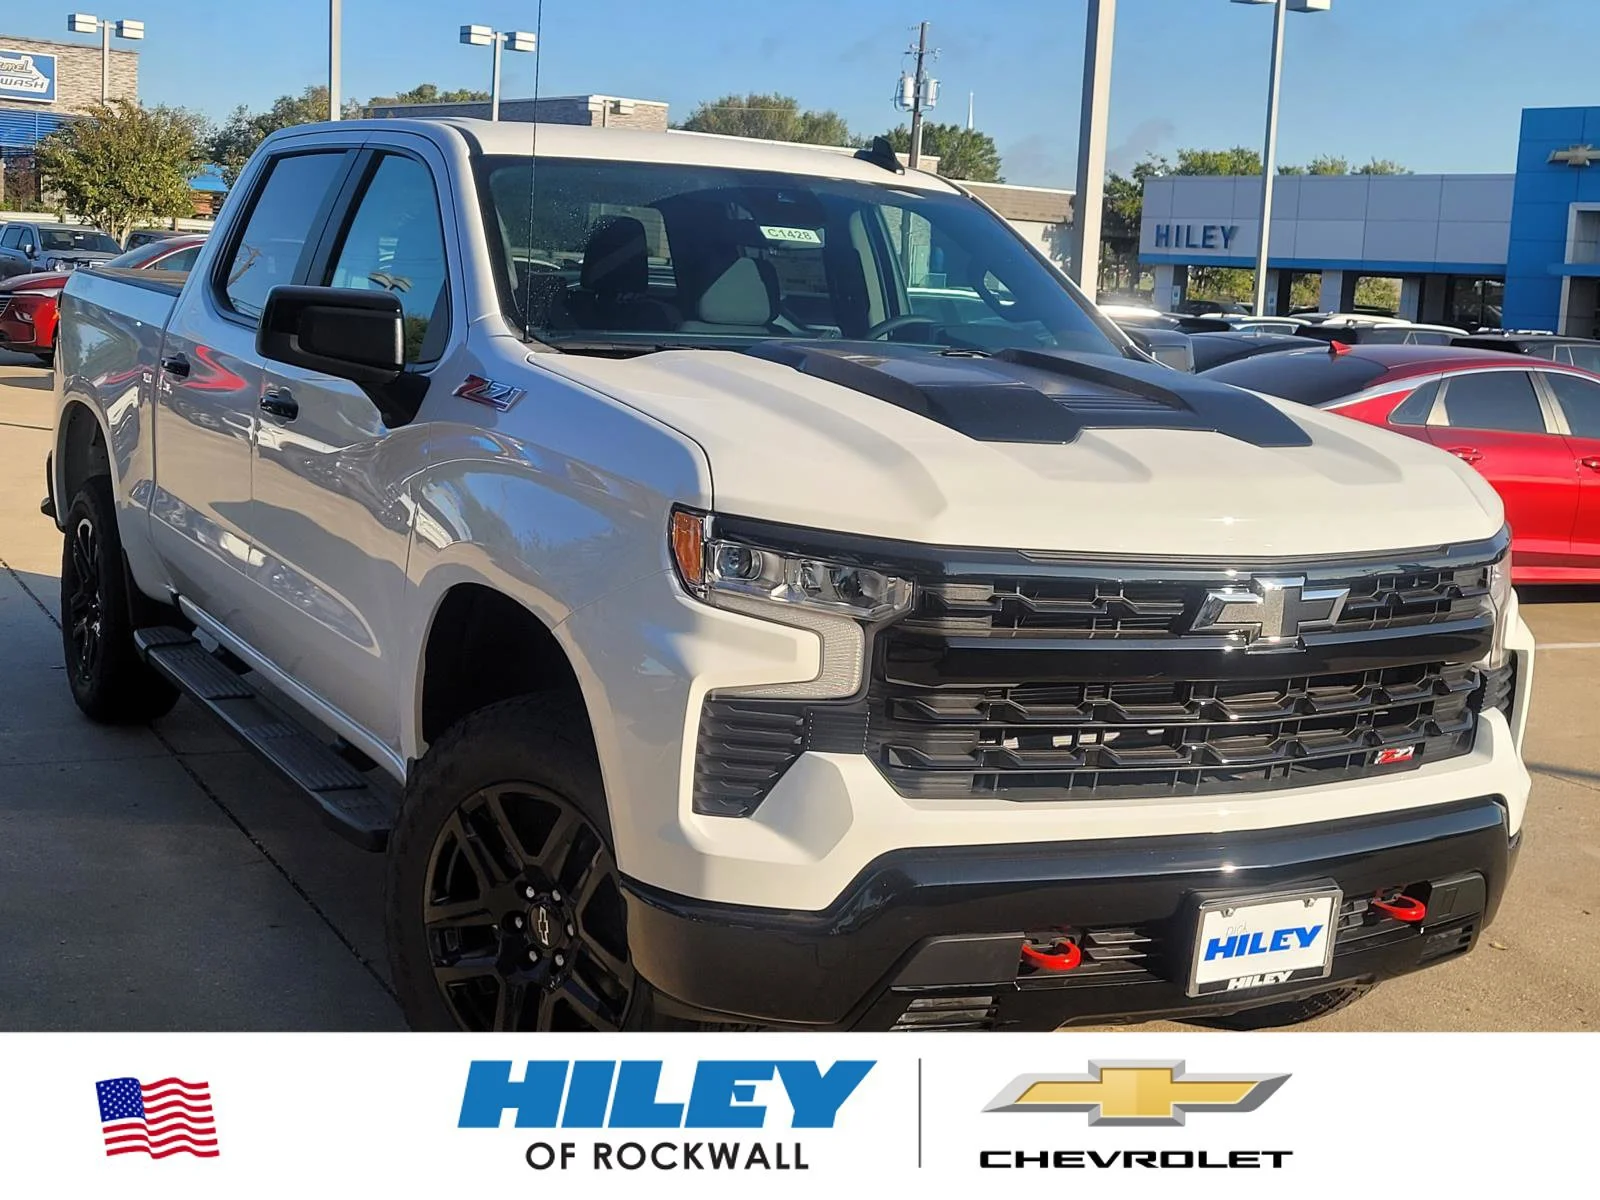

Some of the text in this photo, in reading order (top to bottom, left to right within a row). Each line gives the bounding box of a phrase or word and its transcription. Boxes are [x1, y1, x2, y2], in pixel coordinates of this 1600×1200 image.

[0, 77, 45, 89] WASH
[767, 228, 812, 240] C1428
[1155, 224, 1239, 249] HILEY
[452, 373, 525, 411] Z71
[1374, 745, 1415, 765] Z71
[1204, 924, 1324, 962] HILEY
[1226, 969, 1294, 992] HILEY
